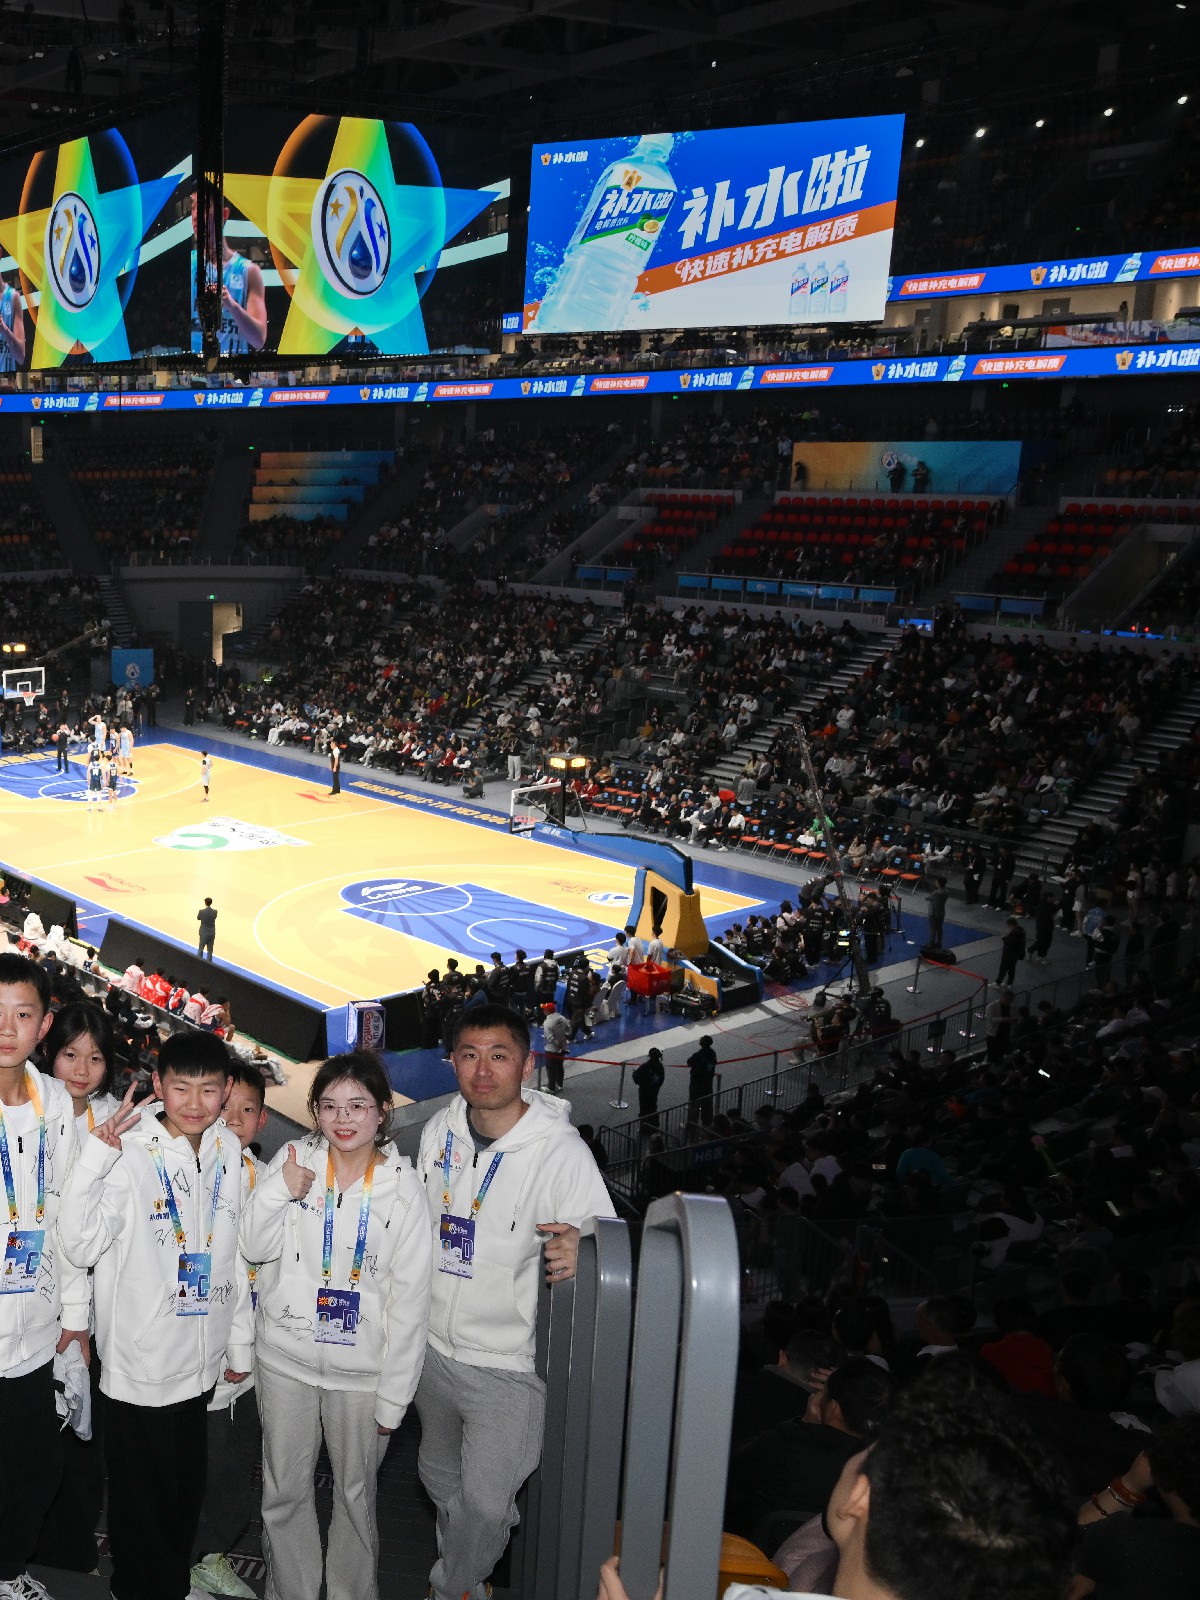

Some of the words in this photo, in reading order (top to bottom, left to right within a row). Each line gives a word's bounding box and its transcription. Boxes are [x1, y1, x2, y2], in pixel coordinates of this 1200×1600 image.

[553, 151, 588, 163] 补水啦
[599, 190, 674, 219] 补水啦
[677, 144, 872, 250] 补水啦
[678, 213, 858, 284] 快速补充电解质
[1050, 261, 1108, 282] 补水啦
[907, 277, 979, 293] 快速补充电解质
[981, 358, 1059, 373] 快速补充电解质
[1137, 349, 1200, 368] 补水啦
[888, 362, 938, 378] 补水啦
[533, 381, 567, 393] 补水啦
[693, 372, 732, 387] 补水啦
[208, 393, 243, 404] 补水啦
[373, 387, 408, 399] 补水啦
[44, 397, 79, 408] 补水啦
[25, 1251, 40, 1275] C
